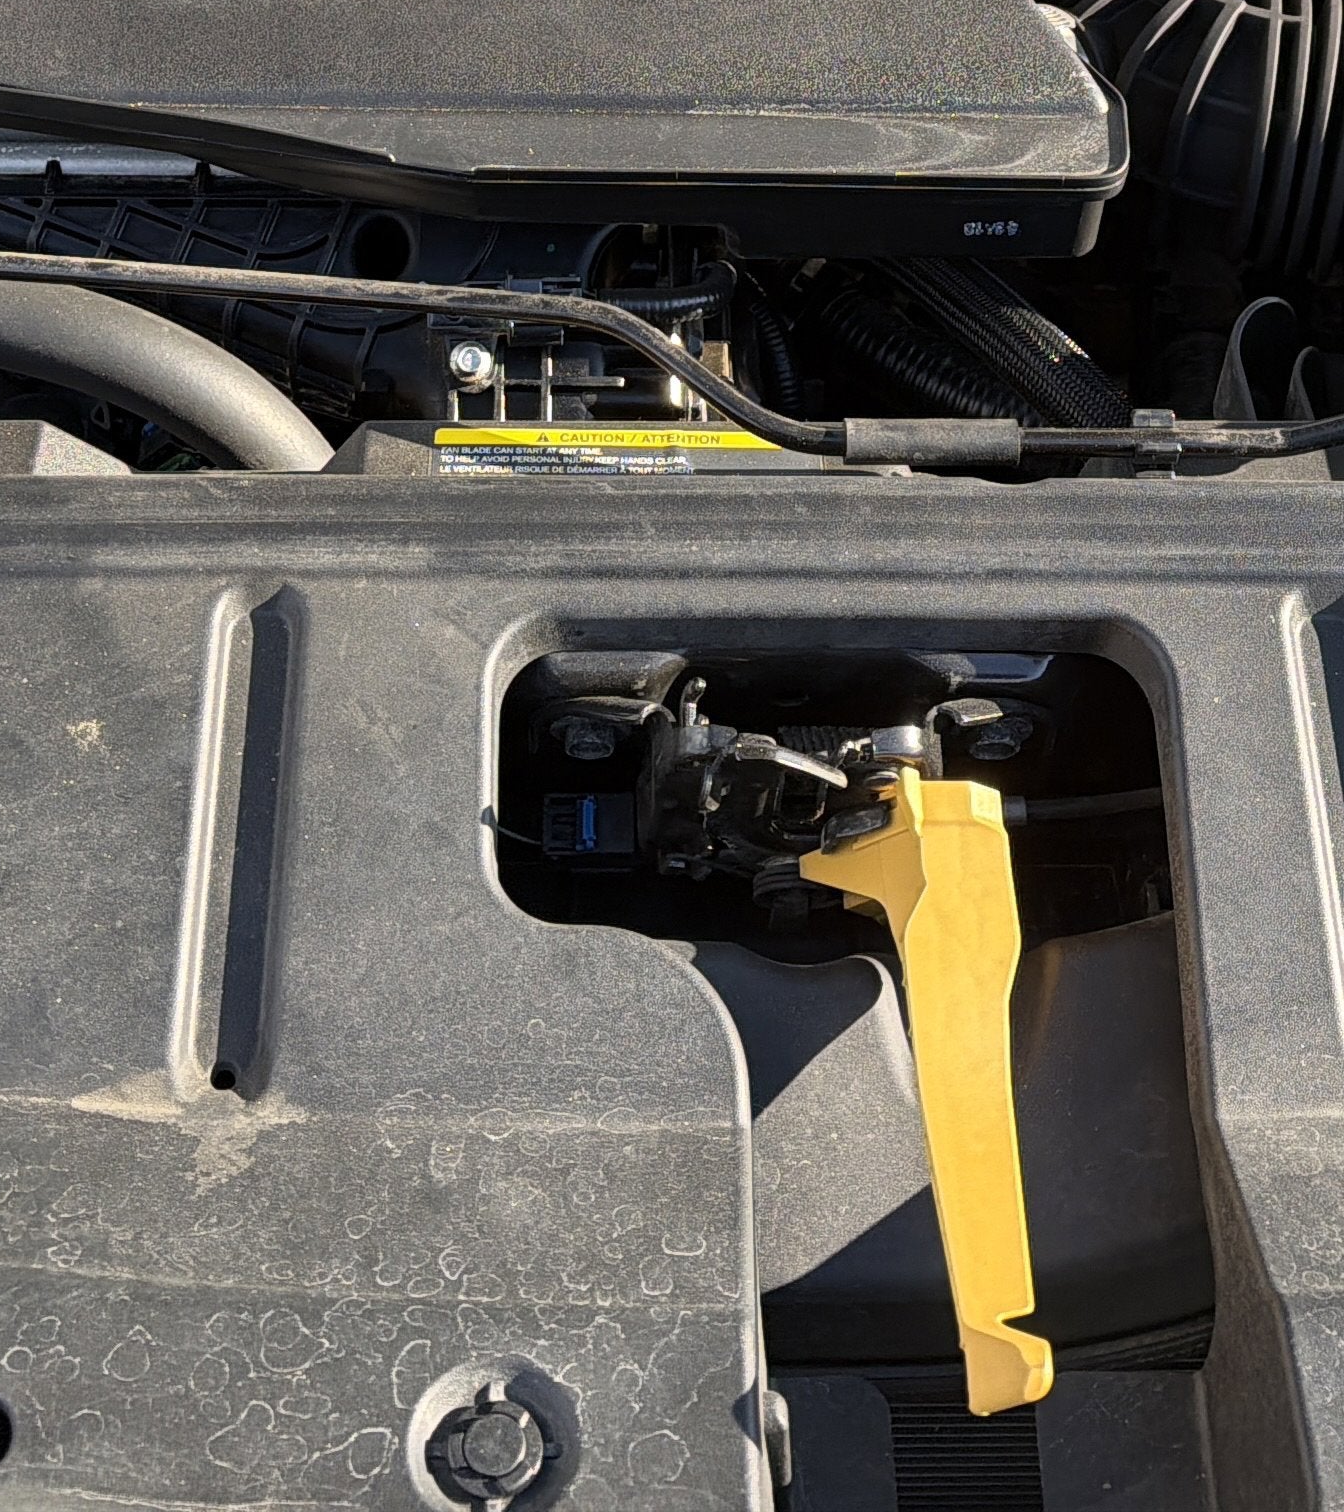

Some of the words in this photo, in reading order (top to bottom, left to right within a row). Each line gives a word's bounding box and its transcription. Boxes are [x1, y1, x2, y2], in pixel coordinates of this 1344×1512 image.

[560, 433, 624, 444] CAUTION
[641, 433, 721, 445] ATTENTION
[461, 446, 492, 455] BLADE
[493, 446, 514, 455] CAN
[515, 447, 543, 455] START
[545, 447, 558, 455] AT
[558, 447, 579, 455] ANY
[440, 454, 454, 463] TO
[454, 454, 480, 463] HELP
[480, 454, 510, 463] AVOID
[511, 455, 562, 463] PERSONAL
[593, 455, 619, 464] KEEP
[620, 456, 653, 465] HANDS
[439, 464, 452, 473] LE
[452, 464, 514, 474] VENTILATEUR
[514, 465, 550, 474] RISQUE
[551, 465, 566, 474] DE
[566, 464, 618, 474] DÉMARRER
[627, 465, 653, 475] TOUT
